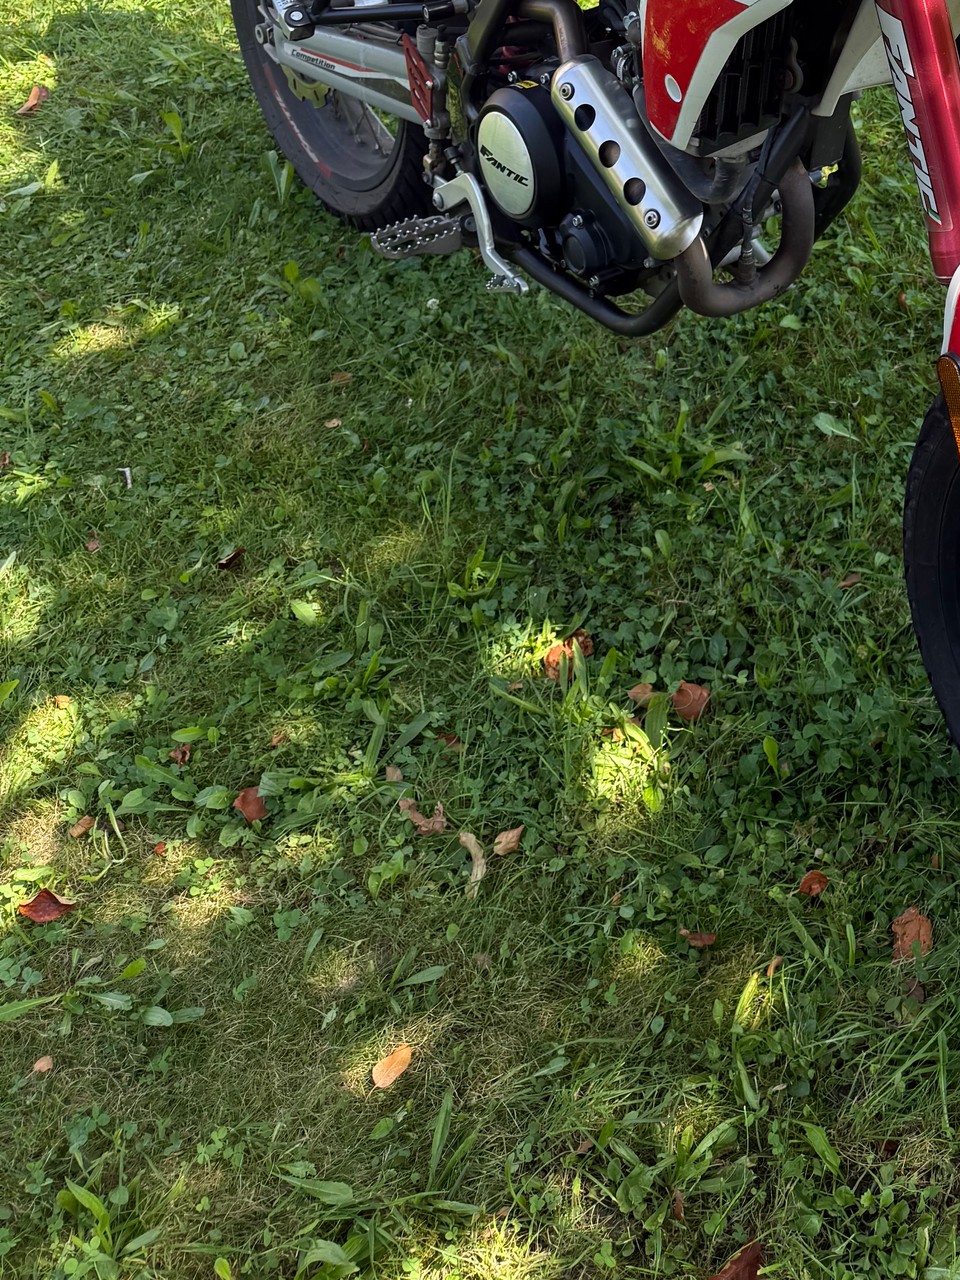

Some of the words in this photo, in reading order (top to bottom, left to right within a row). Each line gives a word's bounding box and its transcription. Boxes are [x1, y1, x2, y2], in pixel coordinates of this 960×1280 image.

[291, 48, 336, 71] Competition
[876, 3, 940, 216] FANTIC
[480, 144, 529, 187] FANTIC
